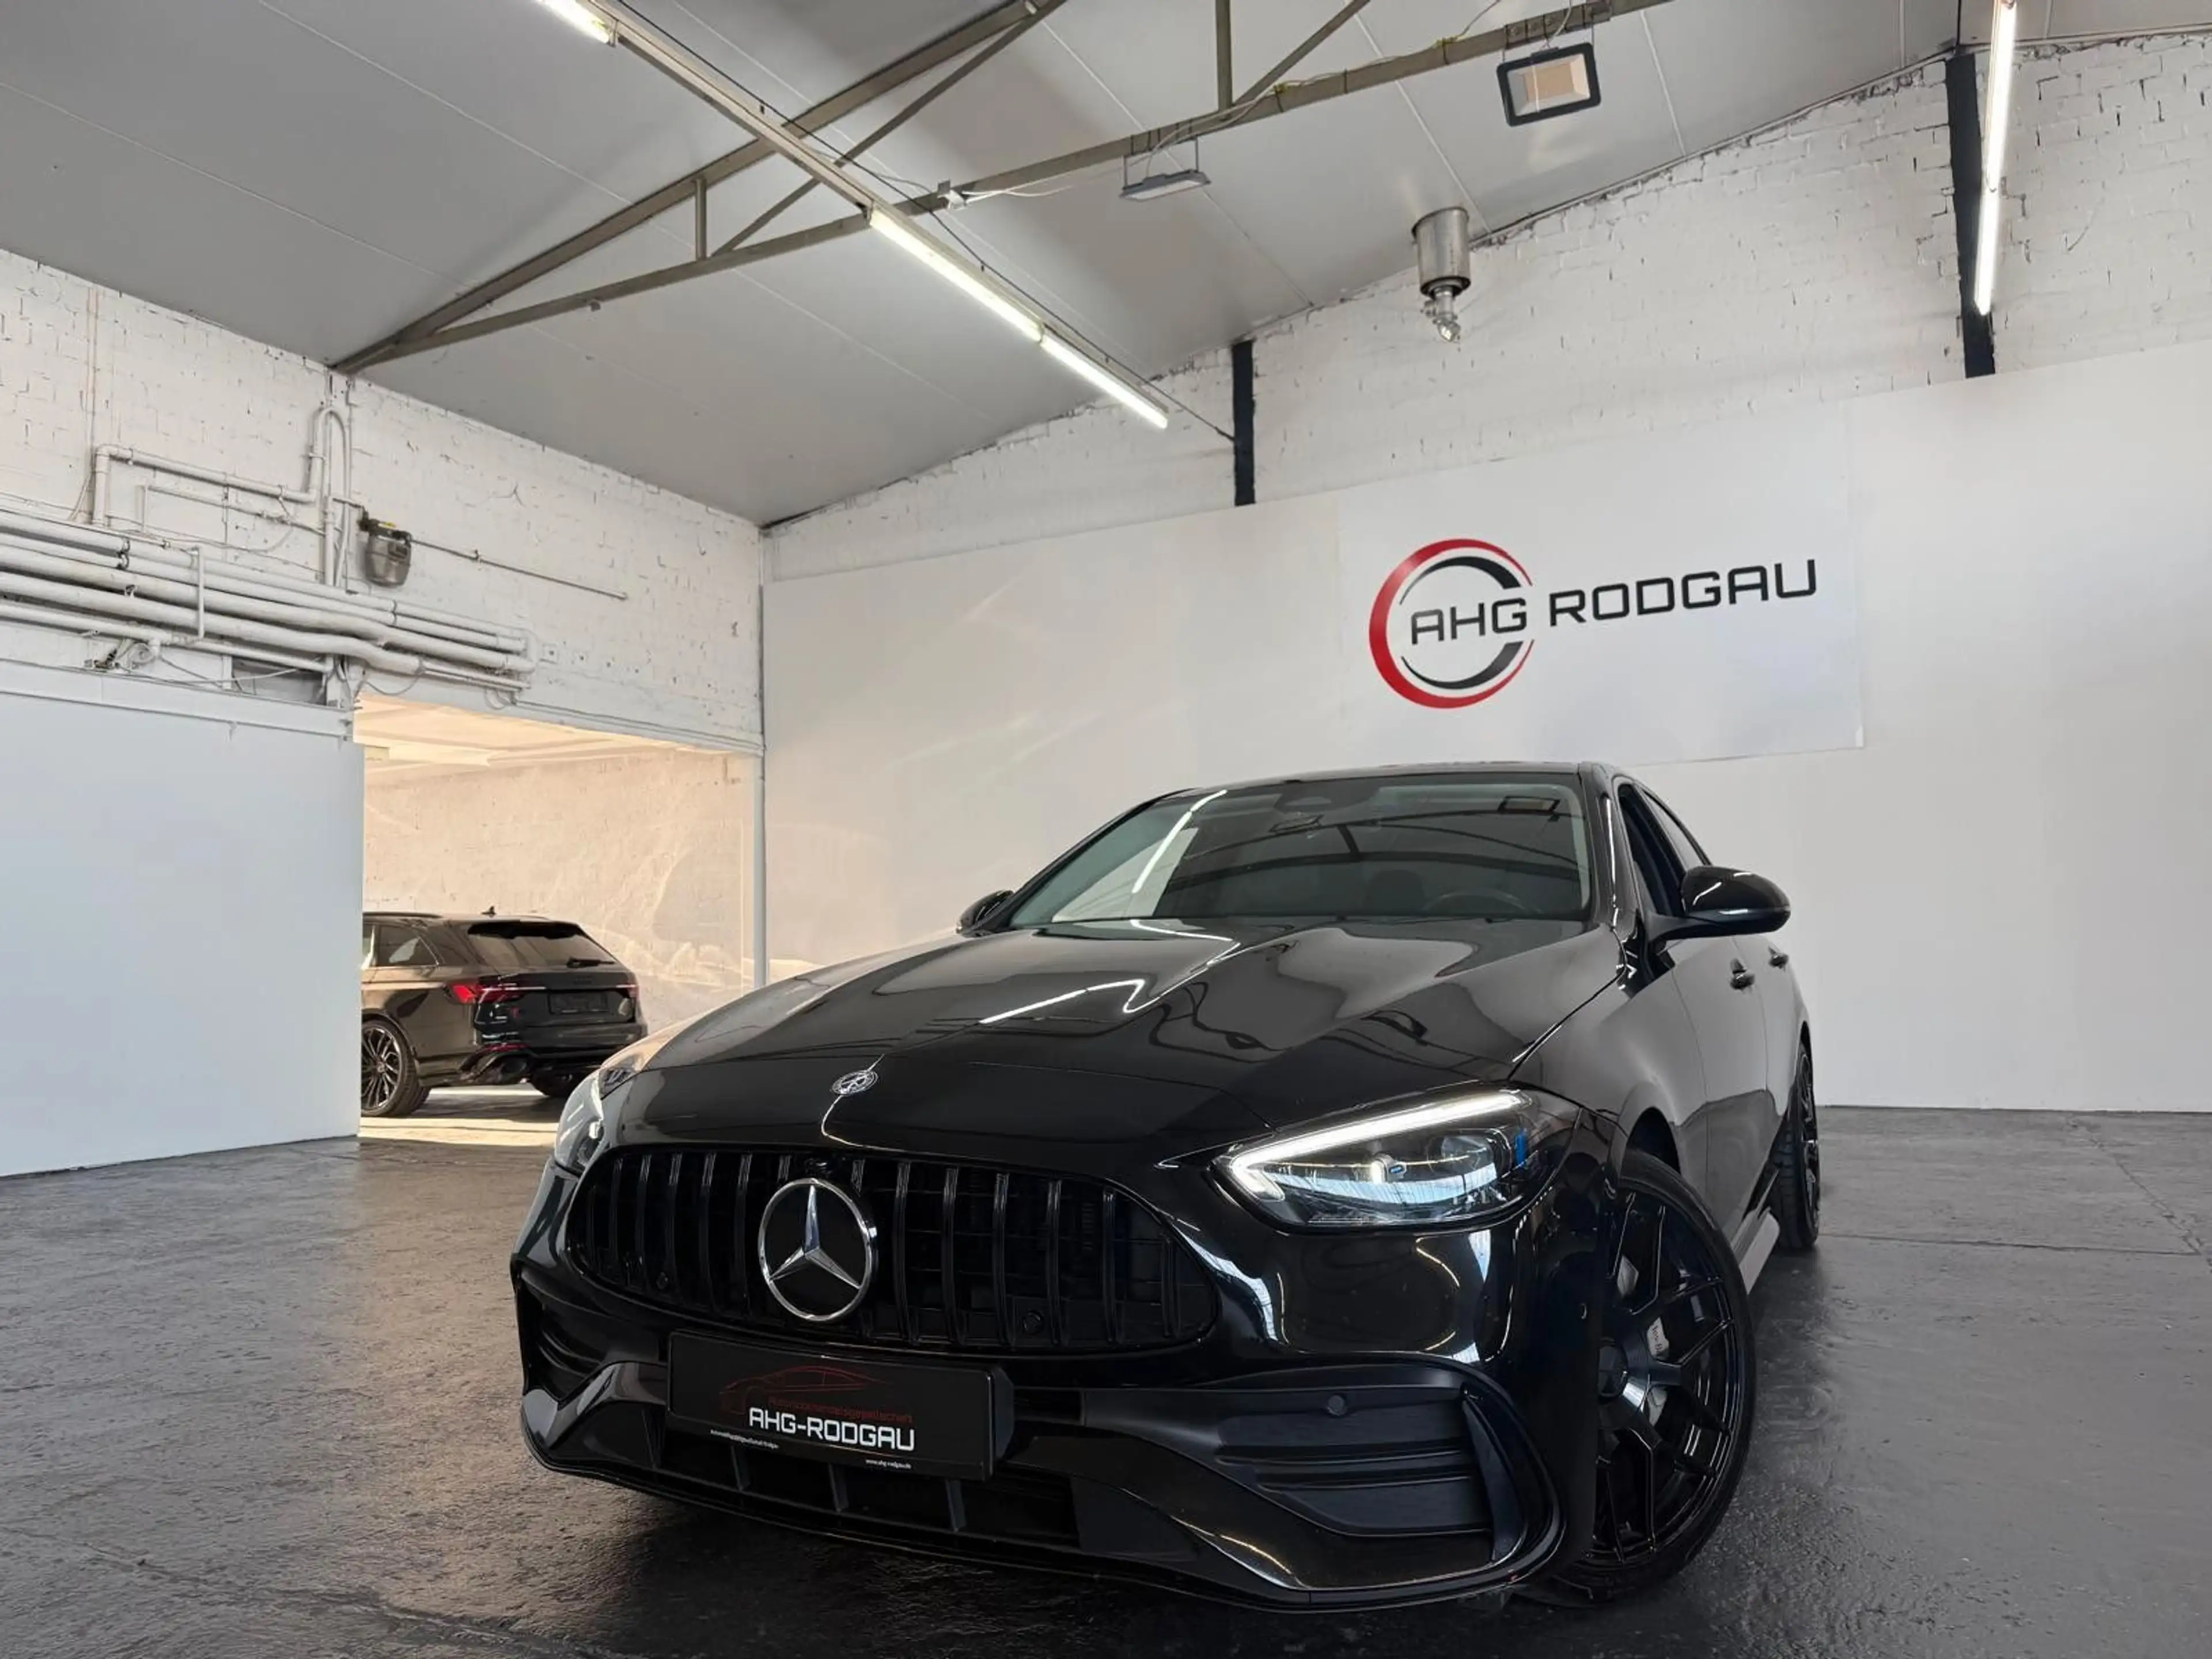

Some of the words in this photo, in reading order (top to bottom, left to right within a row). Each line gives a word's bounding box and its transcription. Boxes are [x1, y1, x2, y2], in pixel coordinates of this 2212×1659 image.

[1411, 597, 1527, 645] AHG
[1549, 559, 1817, 627] RODGAU
[749, 1407, 915, 1451] AHG-RODGAU
